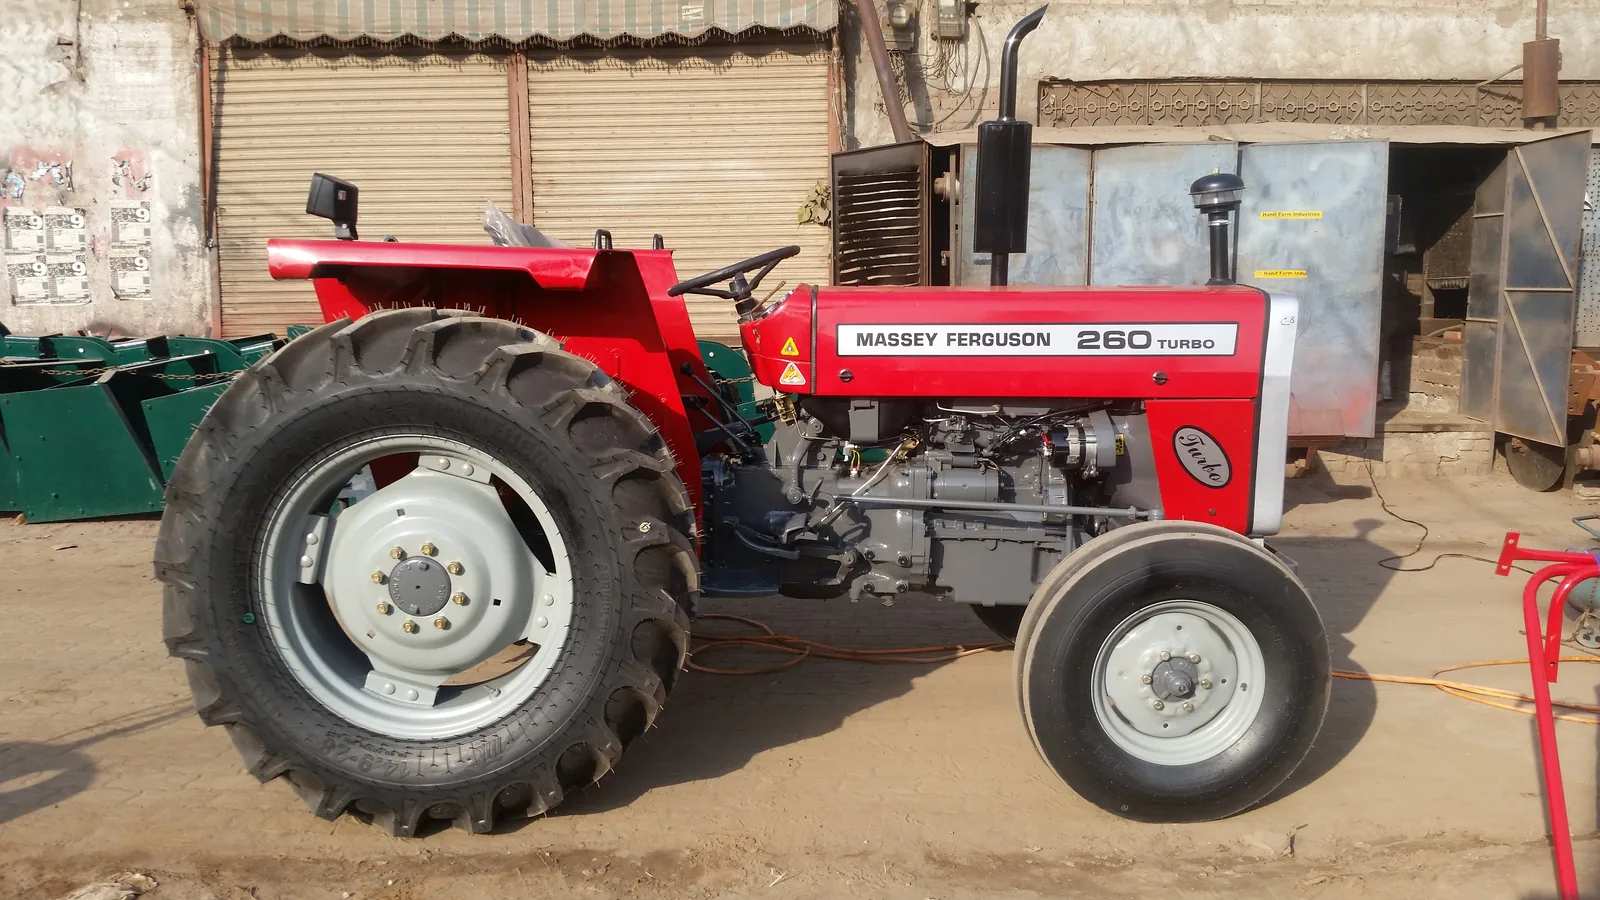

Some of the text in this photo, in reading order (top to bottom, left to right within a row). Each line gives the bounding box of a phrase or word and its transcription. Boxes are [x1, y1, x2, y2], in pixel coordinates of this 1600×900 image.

[70, 215, 85, 229] 9
[135, 208, 150, 222] 9
[32, 262, 47, 276] 9
[71, 262, 86, 276] 9
[134, 257, 149, 271] 9
[856, 330, 1215, 349] MASSEY FERGUSON 260 TURBO
[1178, 433, 1224, 483] Turbo
[322, 738, 410, 780] 14.9-28
